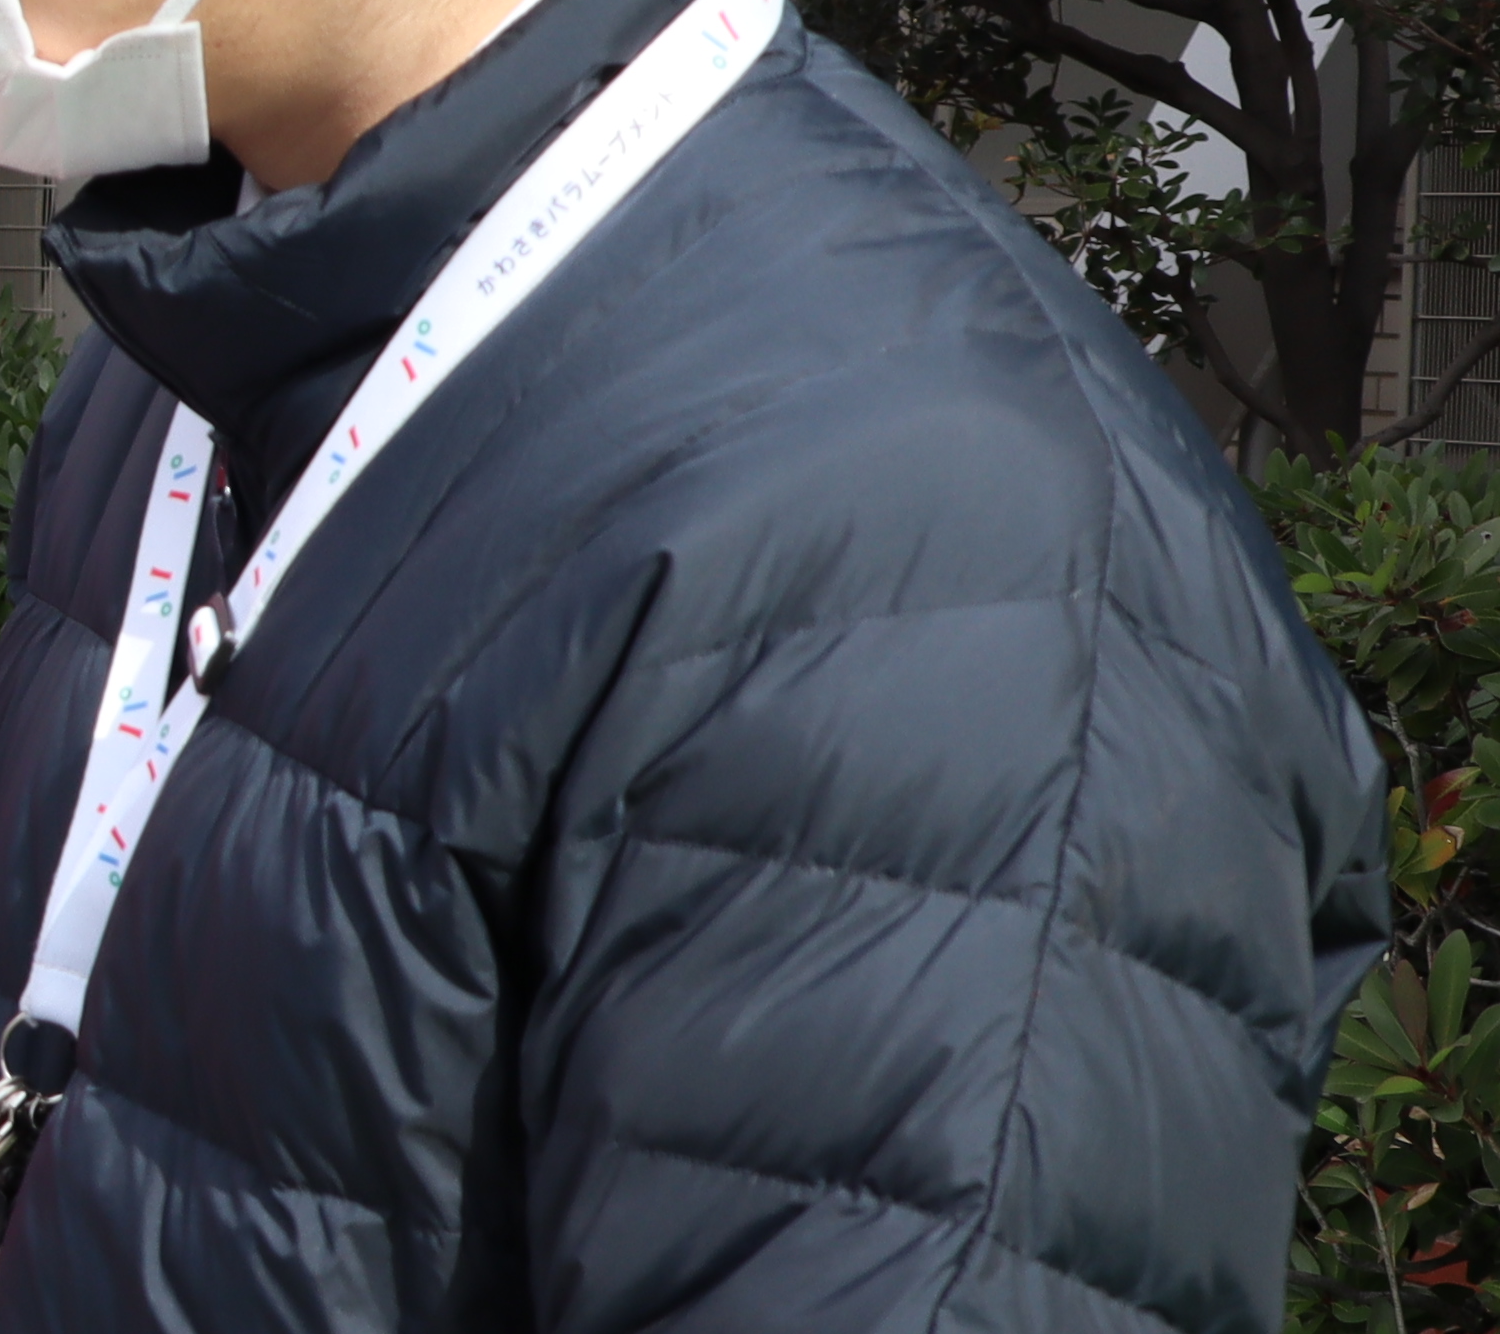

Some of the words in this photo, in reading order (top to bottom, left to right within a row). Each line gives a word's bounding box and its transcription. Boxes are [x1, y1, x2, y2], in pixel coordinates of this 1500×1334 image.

[476, 91, 675, 297] かわさきパラムーブメント
